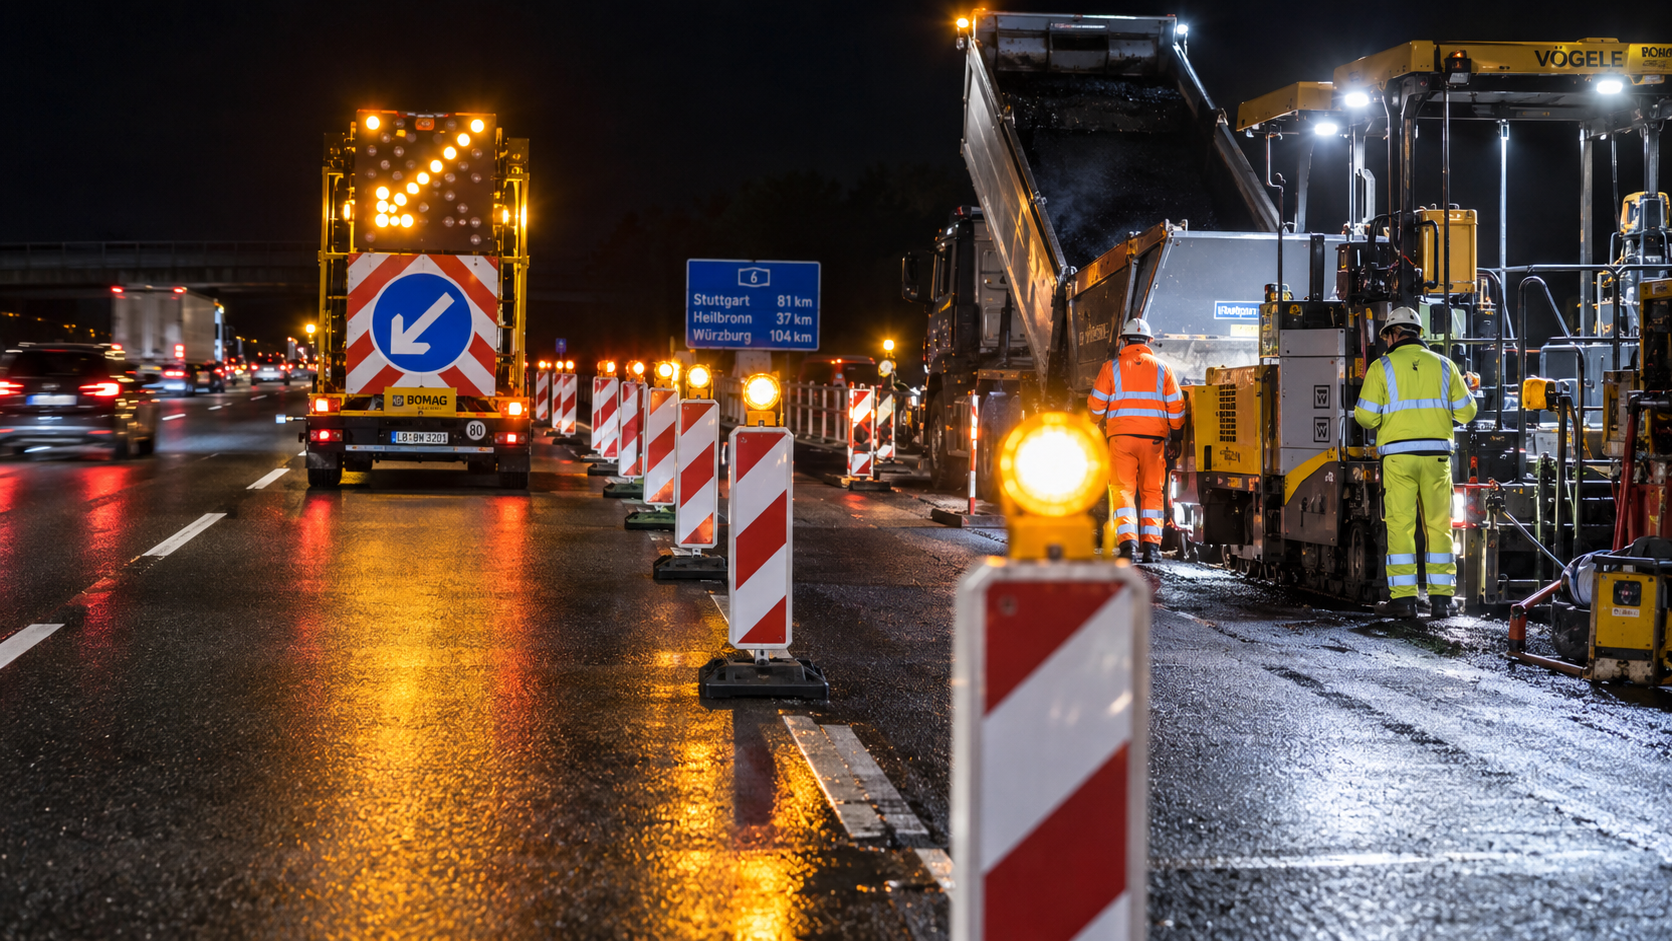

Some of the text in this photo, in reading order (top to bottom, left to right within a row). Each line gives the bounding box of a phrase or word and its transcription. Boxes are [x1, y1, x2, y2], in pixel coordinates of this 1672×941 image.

[1534, 45, 1624, 68] VÖGELE
[750, 271, 758, 284] 6
[693, 293, 813, 309] Stuttgart 81 km
[693, 311, 812, 325] Heilbronn 37 km
[693, 328, 812, 345] Würzburg 104 km
[407, 395, 447, 405] BOMAG
[469, 424, 483, 437] 80
[426, 433, 446, 443] 3201
